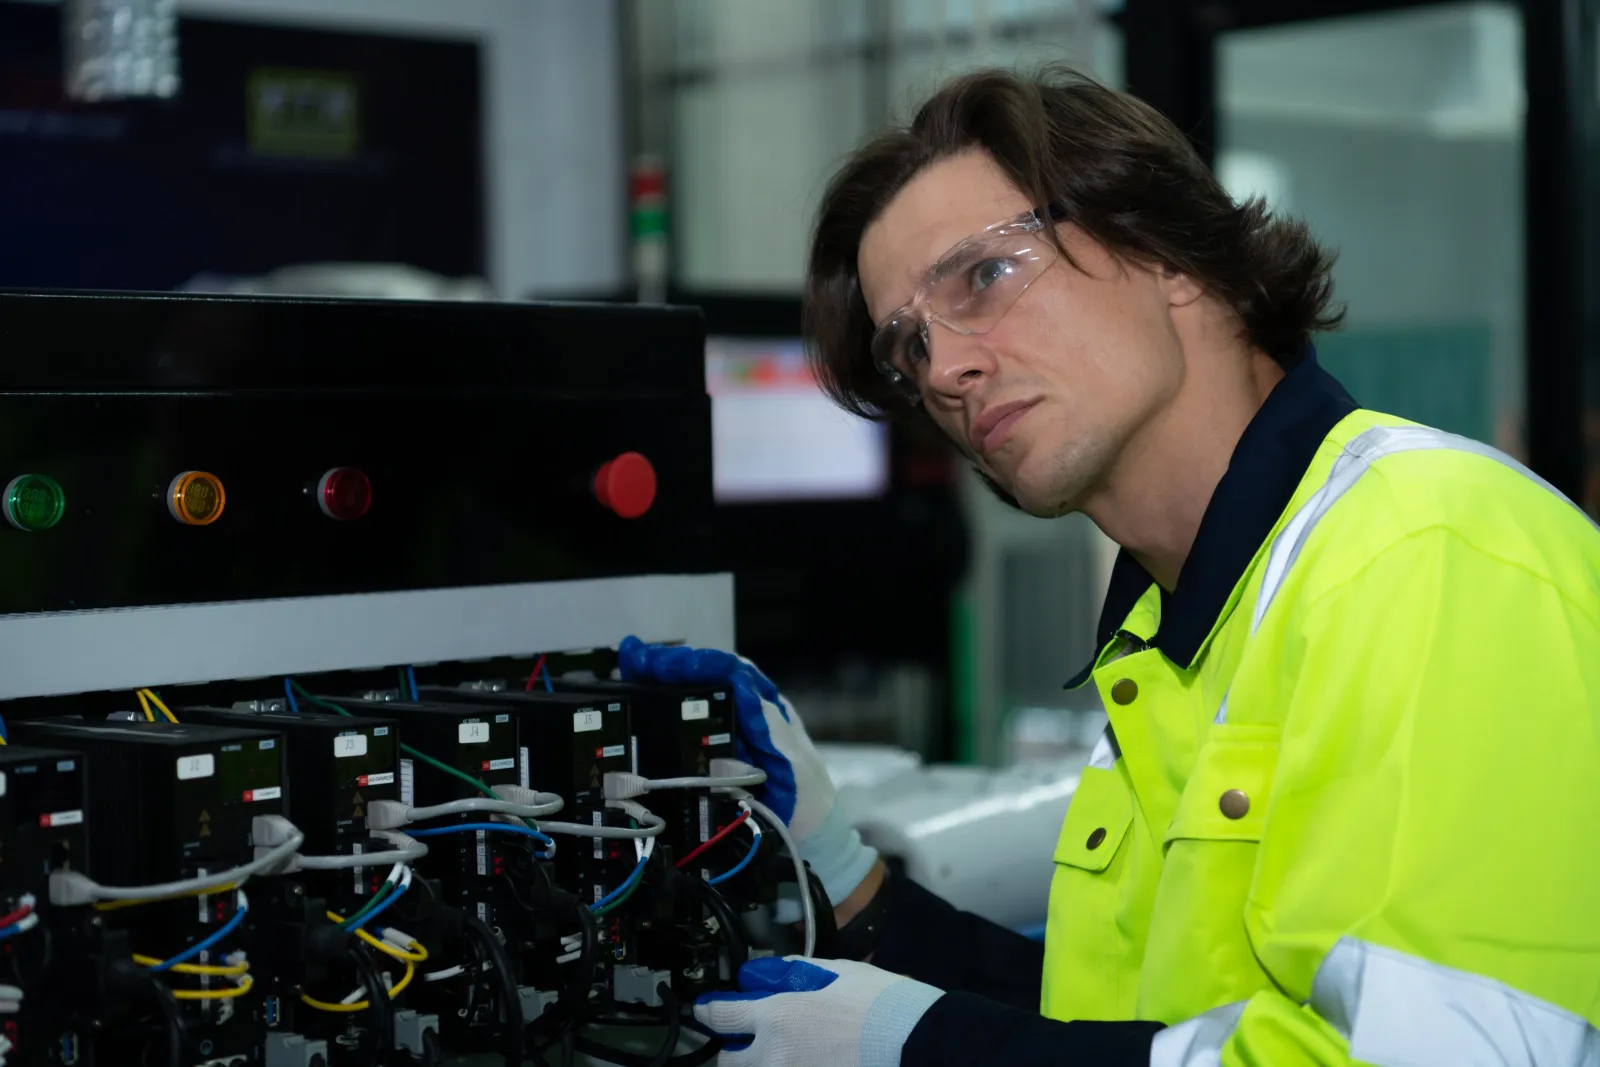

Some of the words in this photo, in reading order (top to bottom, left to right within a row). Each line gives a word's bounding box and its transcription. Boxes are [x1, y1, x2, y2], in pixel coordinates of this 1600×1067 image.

[583, 714, 593, 725] J5
[470, 726, 479, 737] J4
[344, 738, 355, 750] J3
[188, 758, 199, 772] J2
